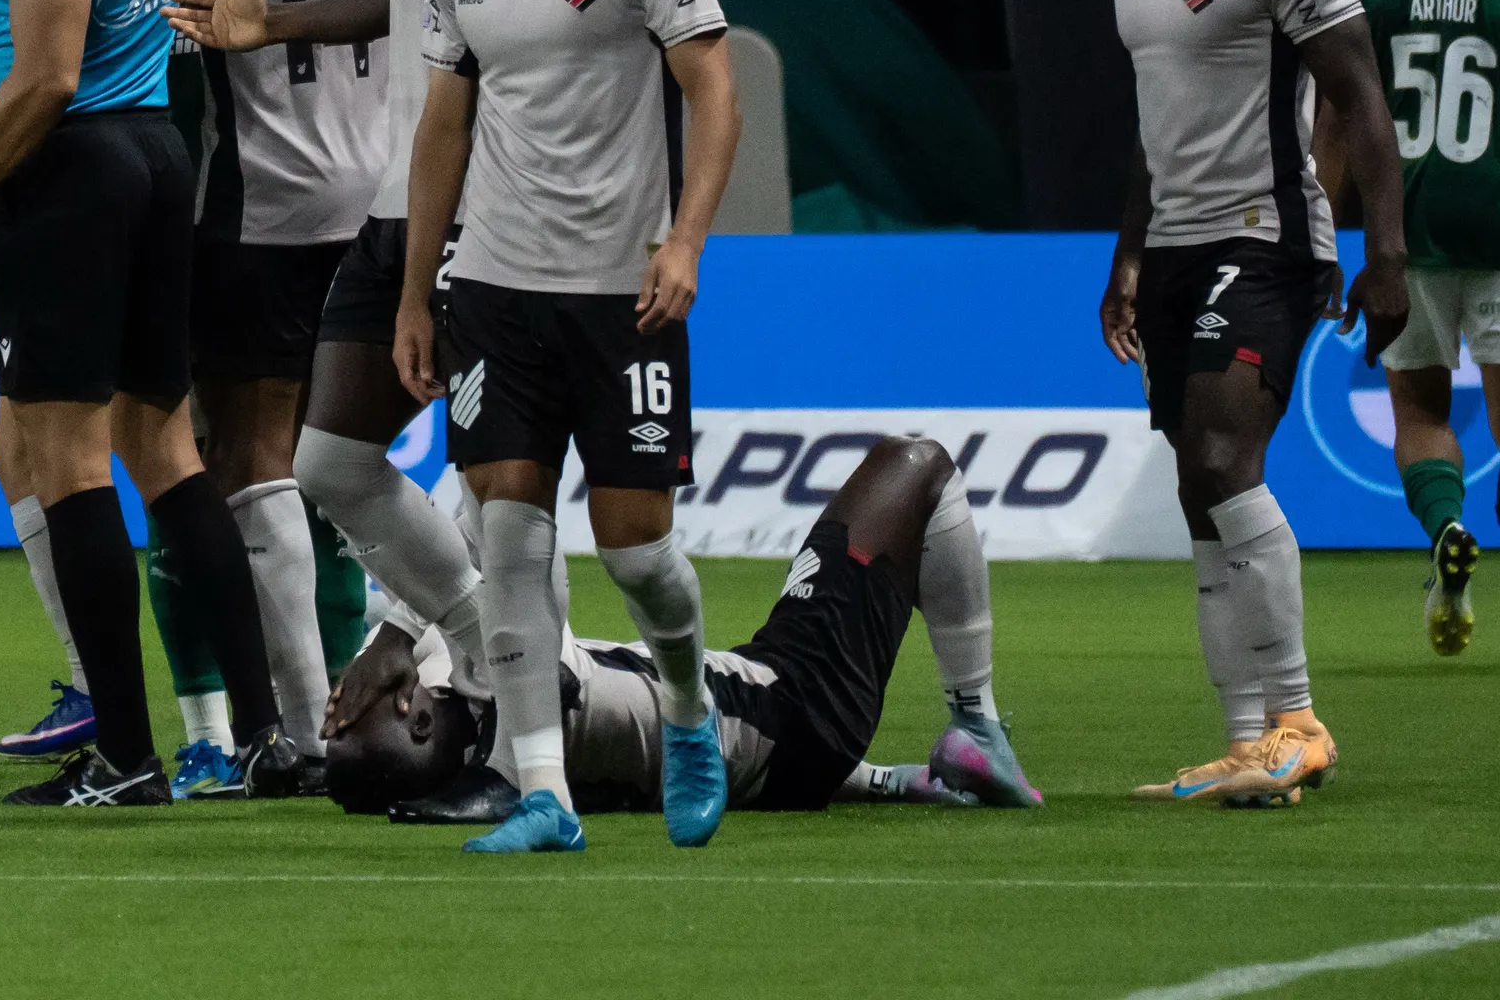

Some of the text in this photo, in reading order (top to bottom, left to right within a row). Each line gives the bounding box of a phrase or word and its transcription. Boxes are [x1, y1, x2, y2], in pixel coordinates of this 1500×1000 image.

[1390, 33, 1498, 164] 56
[1206, 265, 1240, 305] 7
[623, 362, 672, 415] 16
[632, 443, 667, 453] umbro
